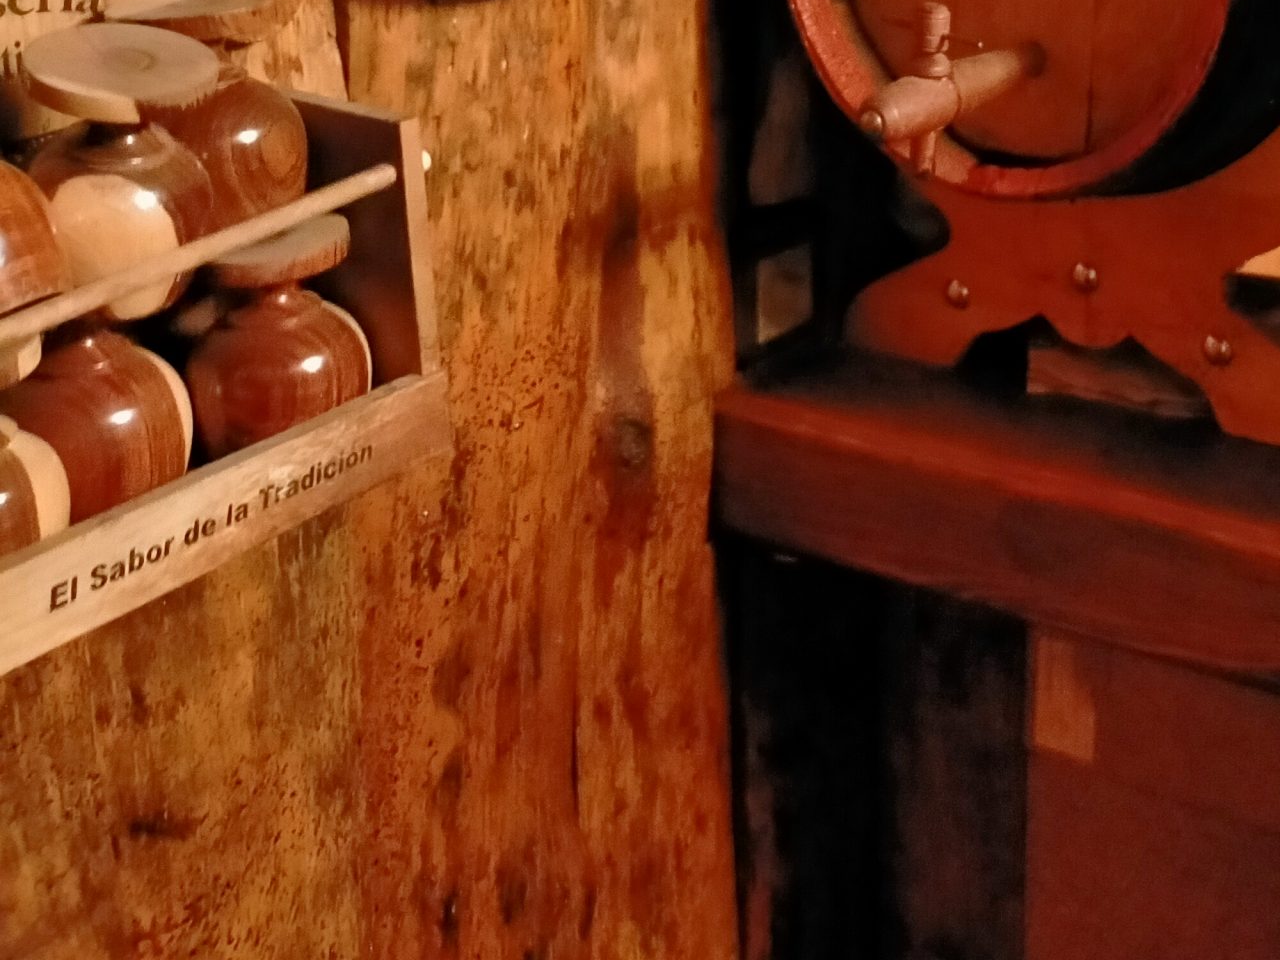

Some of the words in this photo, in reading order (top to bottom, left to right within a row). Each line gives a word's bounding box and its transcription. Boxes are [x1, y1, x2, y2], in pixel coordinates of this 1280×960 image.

[50, 575, 78, 613] El
[89, 536, 175, 590] Sabor
[184, 519, 216, 546] de
[226, 502, 249, 527] la
